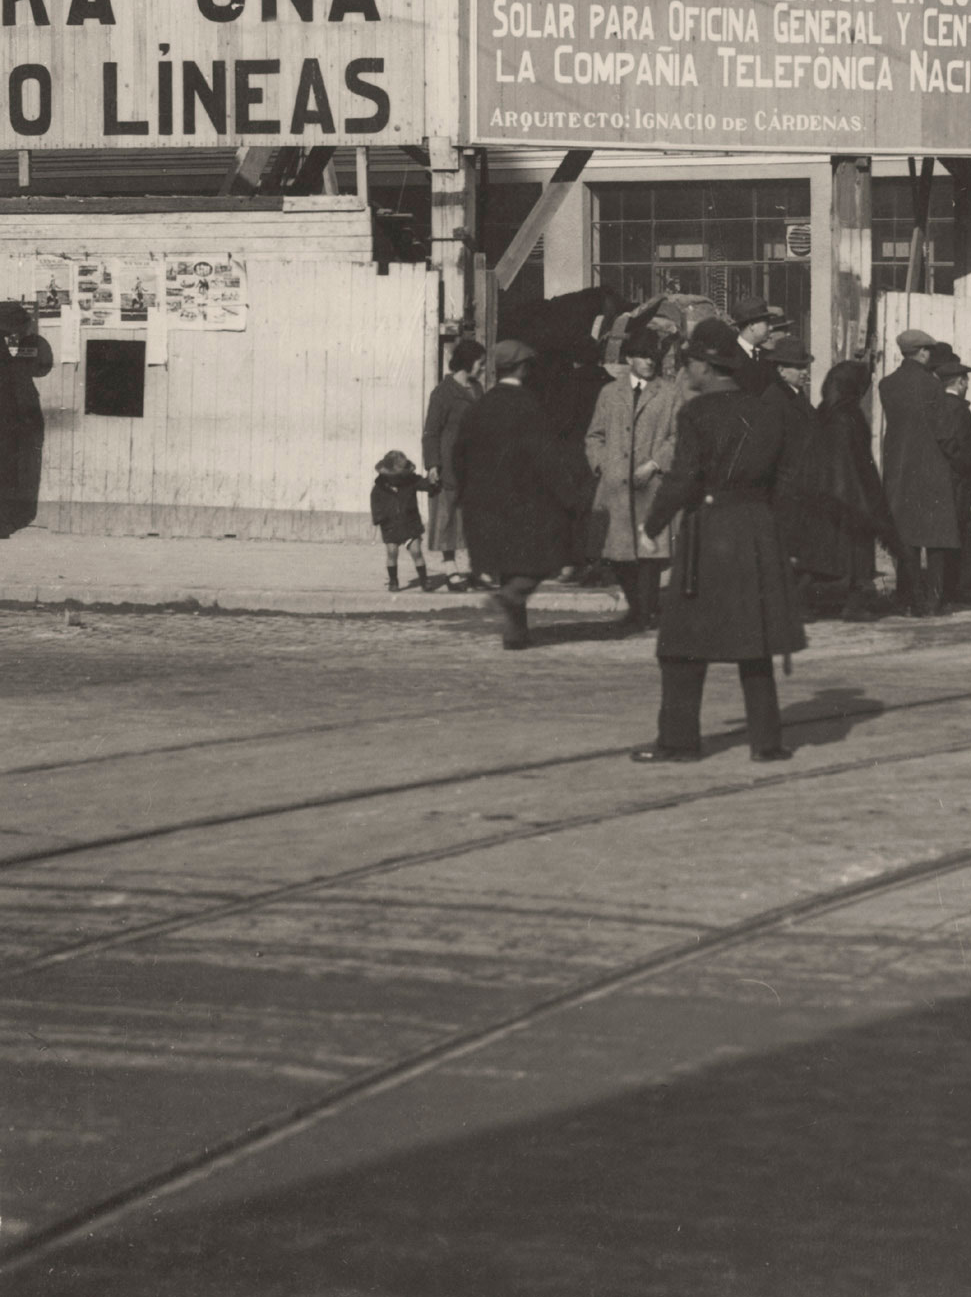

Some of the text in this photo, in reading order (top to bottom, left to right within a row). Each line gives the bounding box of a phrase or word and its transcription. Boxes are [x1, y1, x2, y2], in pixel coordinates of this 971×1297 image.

[589, 4, 655, 41] PARA
[668, 0, 760, 43] OFICINA
[773, 2, 883, 45] GENERAL
[896, 11, 911, 46] Y
[102, 42, 391, 137] LÍNEAS
[495, 48, 537, 84] LA
[717, 46, 894, 92] TELEFÓNICA
[490, 107, 631, 133] ARQUITECTO:
[634, 107, 717, 131] IGNACIO
[722, 116, 748, 132] DE
